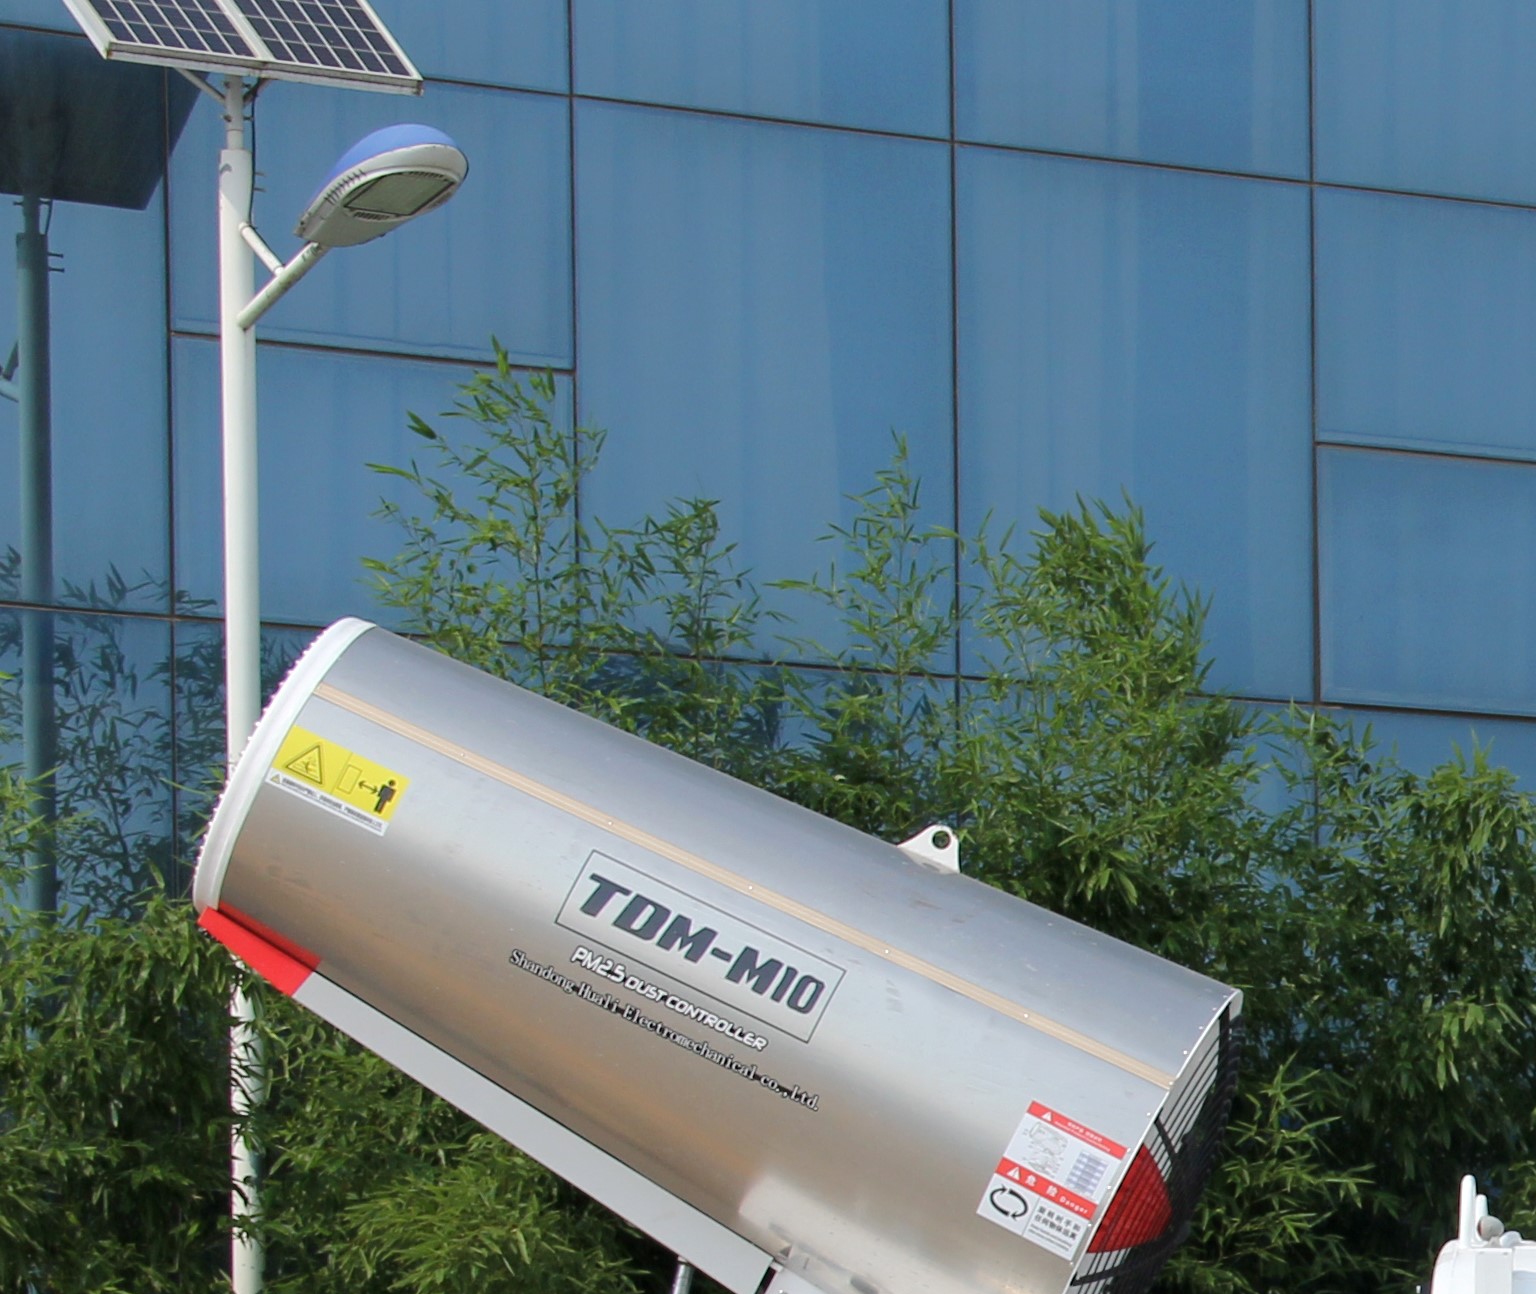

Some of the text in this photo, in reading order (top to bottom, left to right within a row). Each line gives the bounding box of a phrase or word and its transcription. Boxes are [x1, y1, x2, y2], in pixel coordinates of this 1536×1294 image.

[570, 945, 769, 1051] PM2.5 DUST CONTROLLER
[579, 873, 826, 1015] TDM-M10
[510, 949, 577, 995] Shandong
[577, 982, 620, 1014] Huali
[623, 1003, 758, 1081] Electromechanical
[1059, 1196, 1088, 1214] Danger
